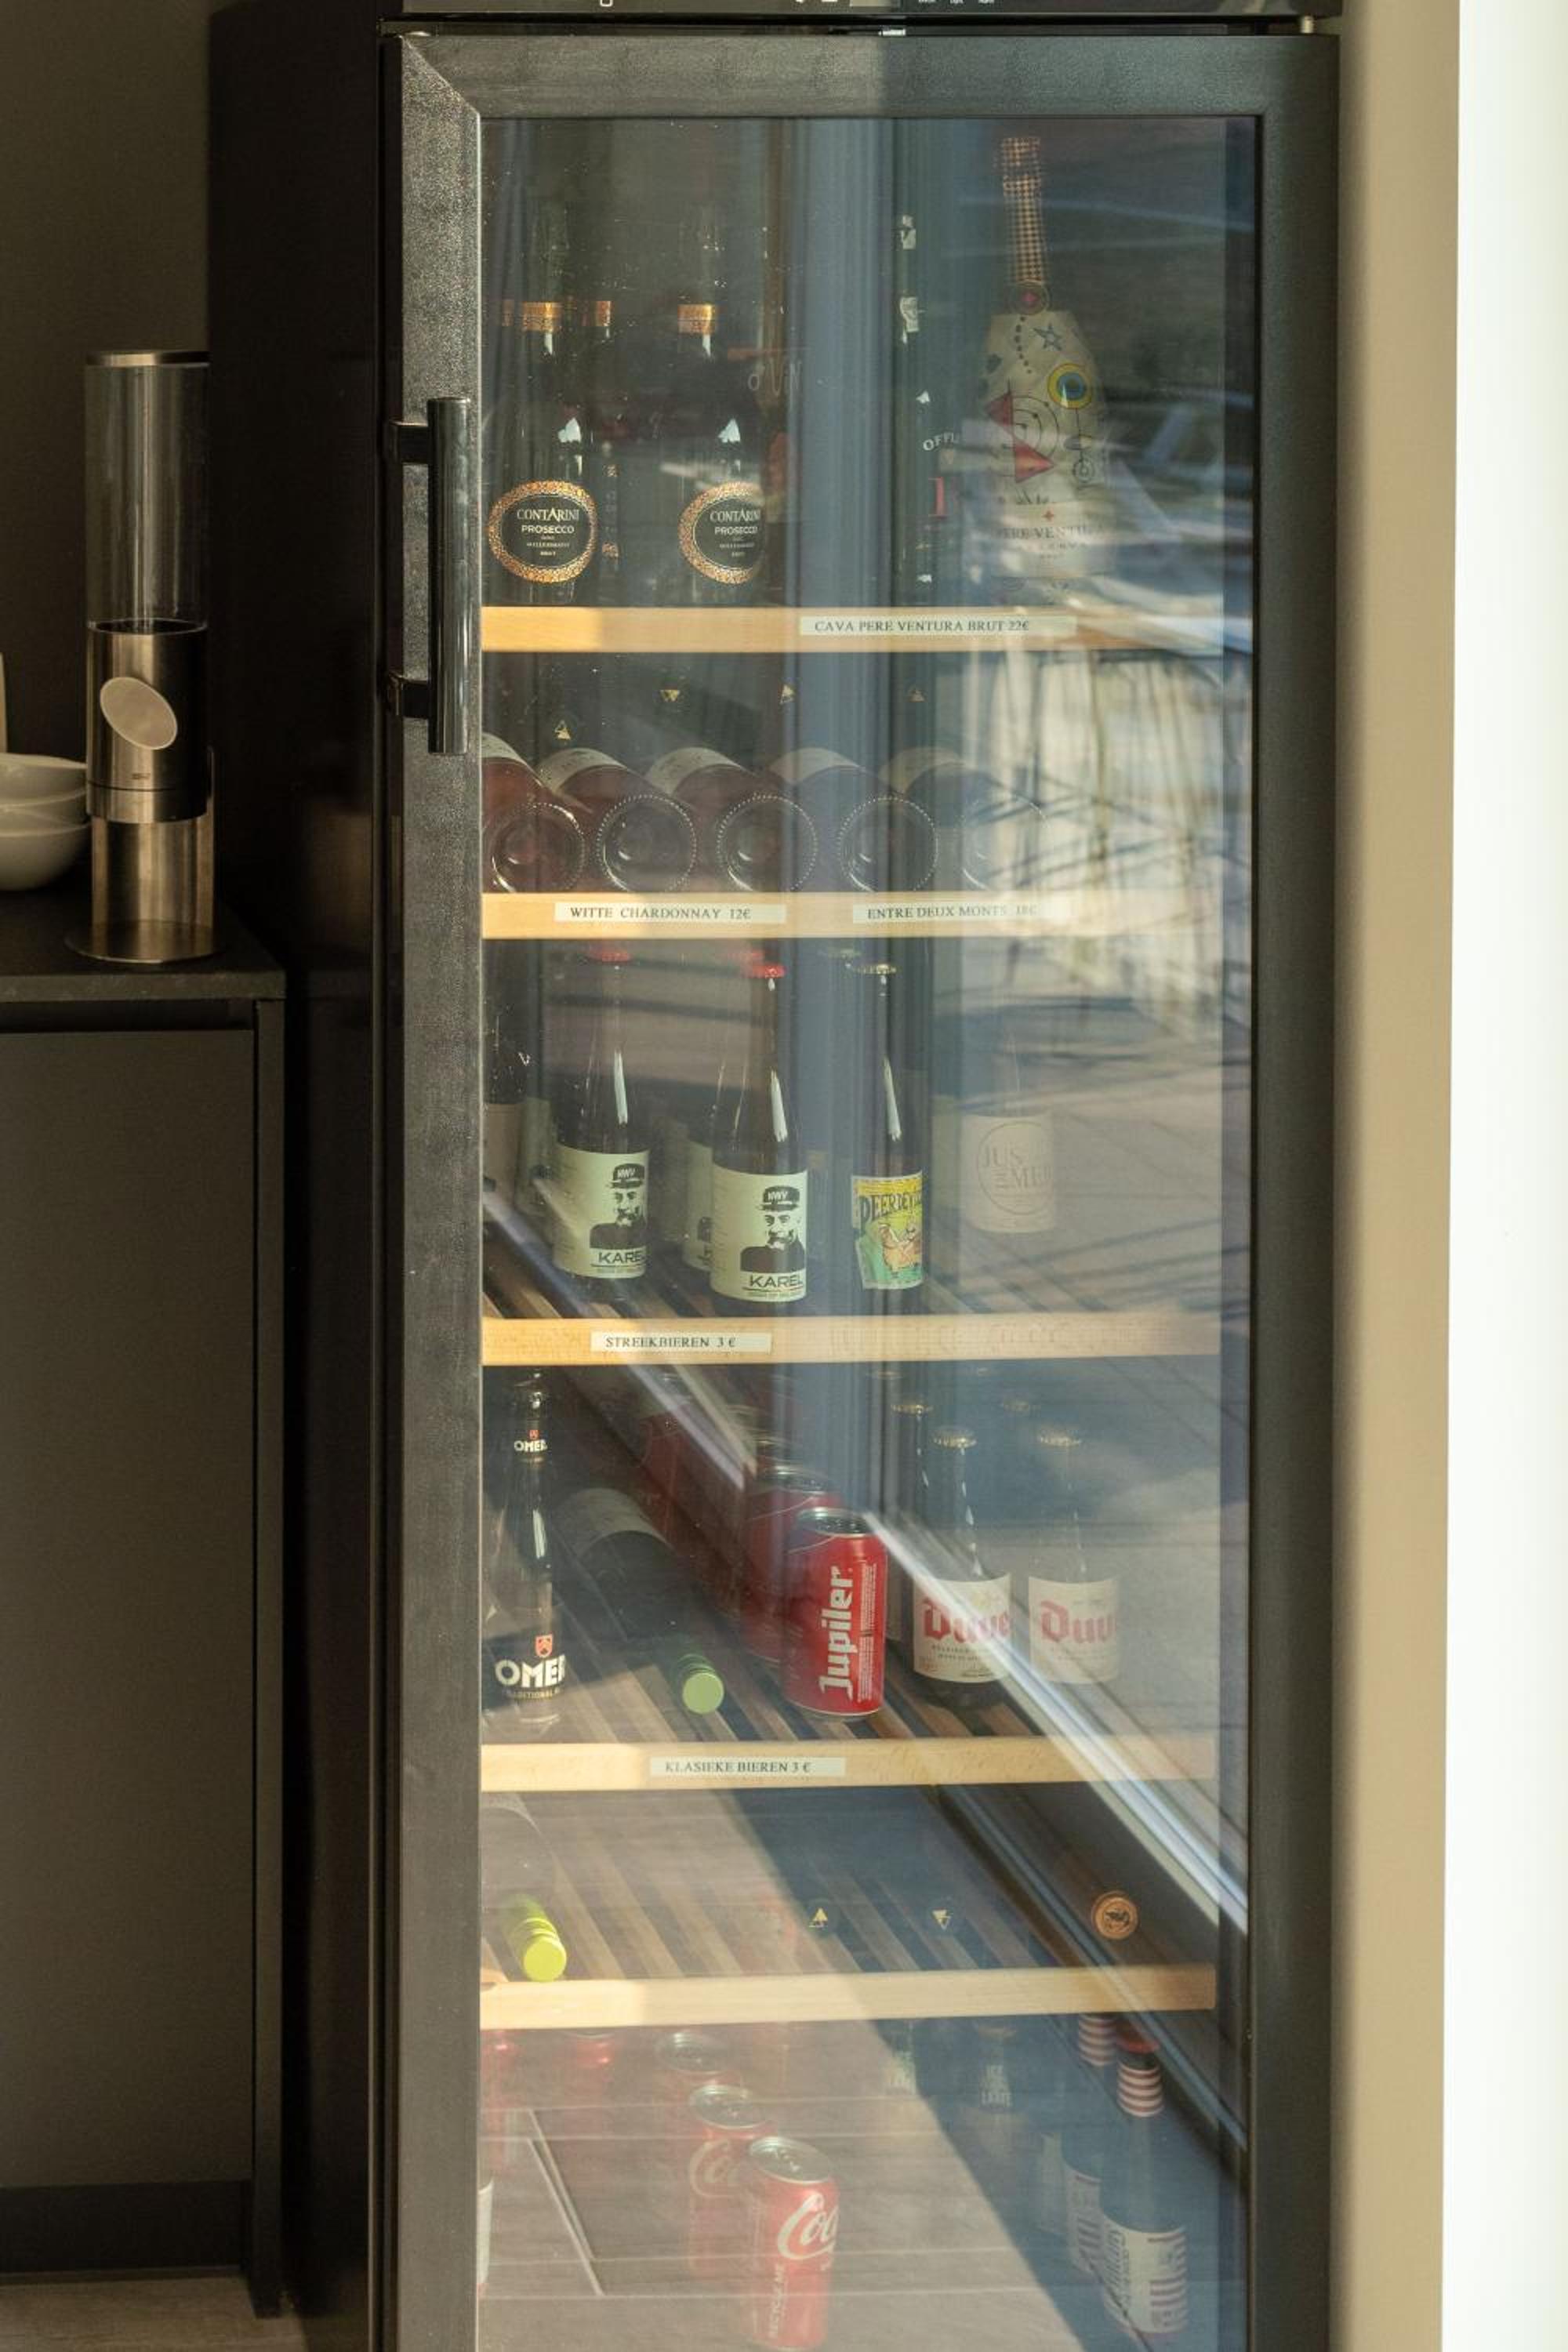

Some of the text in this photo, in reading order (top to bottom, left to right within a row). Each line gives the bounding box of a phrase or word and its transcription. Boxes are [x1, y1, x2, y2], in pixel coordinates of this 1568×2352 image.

[517, 507, 579, 522] CONTARINI
[521, 524, 575, 534] PROSECCO
[815, 621, 854, 632] CAVA
[857, 620, 894, 632] PERE
[897, 620, 964, 632] VENTURA
[967, 619, 1004, 631] BRUT
[570, 907, 751, 920] WITTE CHARDONNAY 12€
[867, 907, 913, 919] ENTRE
[916, 906, 955, 918] DEUX
[750, 1274, 804, 1287] KAREL
[605, 1337, 710, 1348] STREEKBIEREN
[818, 1566, 858, 1700] Jupiler
[666, 1762, 734, 1773] KLASIEKE
[737, 1762, 788, 1773] BIEREN
